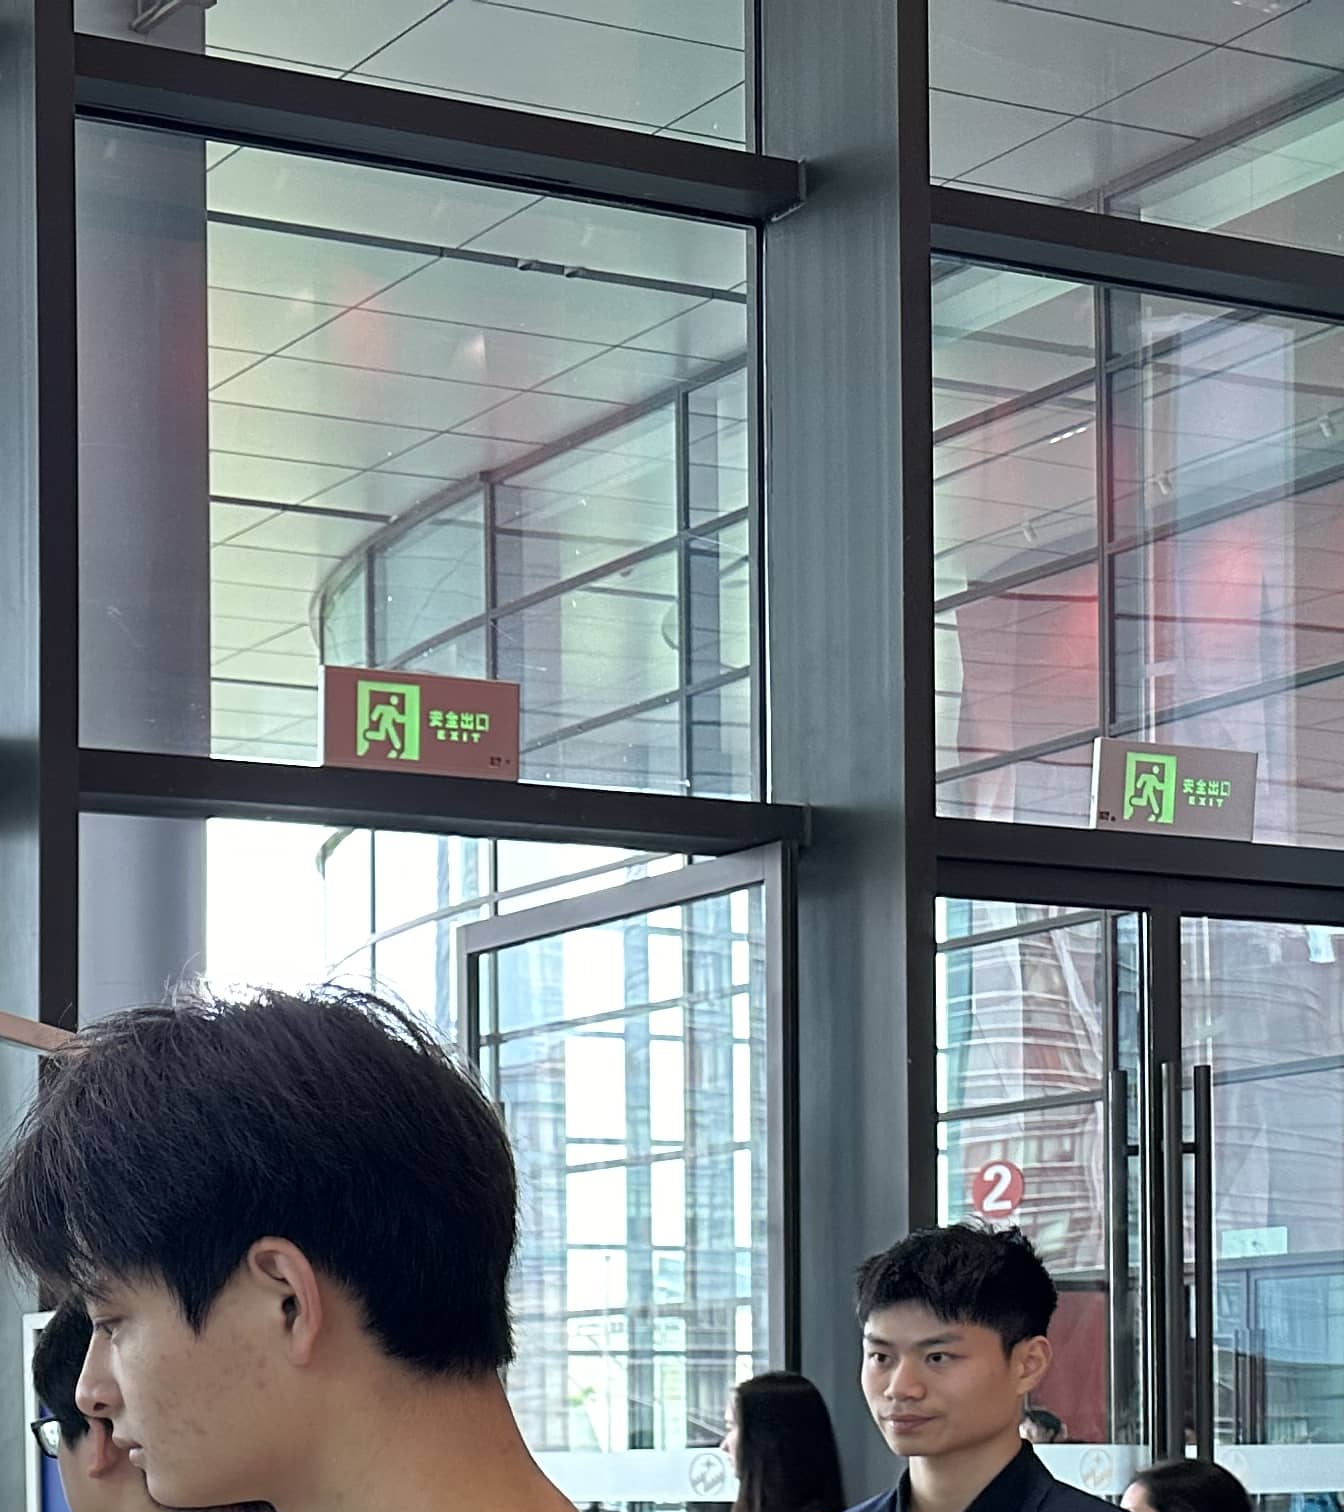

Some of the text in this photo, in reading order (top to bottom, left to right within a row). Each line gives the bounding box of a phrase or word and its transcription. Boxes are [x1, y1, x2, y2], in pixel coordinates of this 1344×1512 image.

[428, 709, 490, 732] 安全出口
[437, 730, 482, 743] EXIT
[1182, 777, 1231, 797] 安全出口
[1188, 796, 1225, 808] EXIT
[983, 1163, 1013, 1211] 2
